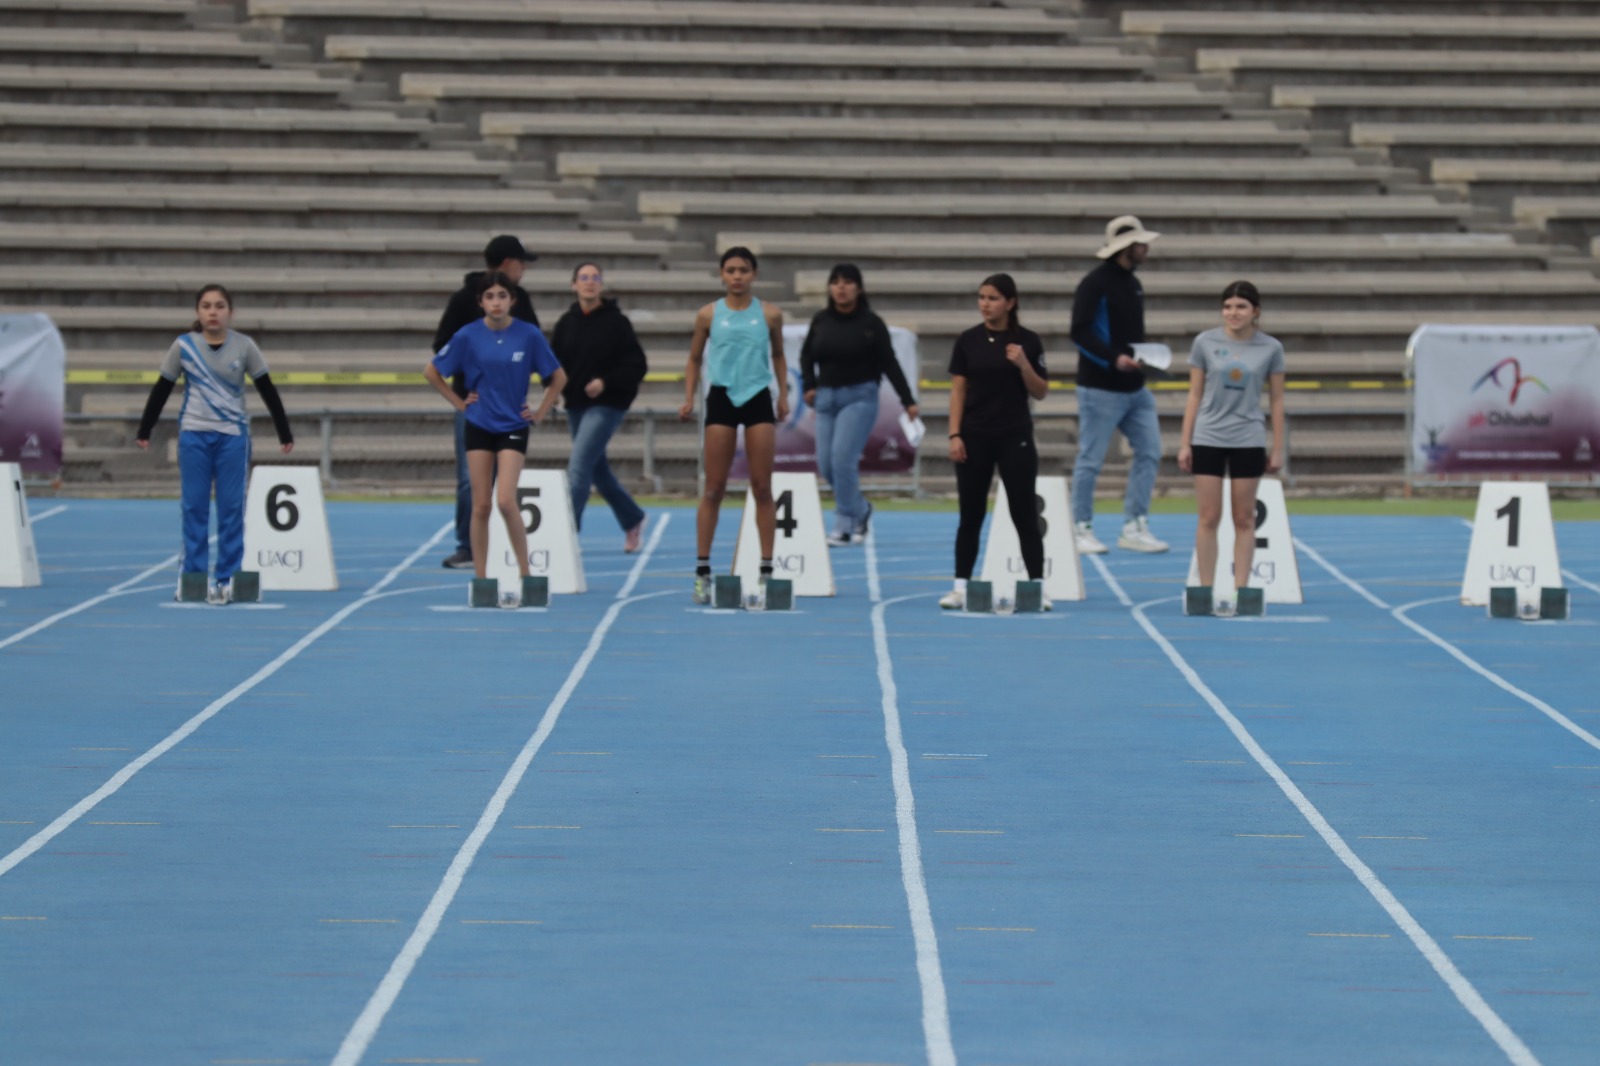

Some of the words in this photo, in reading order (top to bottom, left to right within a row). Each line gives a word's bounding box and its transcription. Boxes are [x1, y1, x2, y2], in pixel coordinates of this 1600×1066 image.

[266, 484, 299, 531] 6
[517, 488, 542, 534] 5
[775, 490, 797, 538] 4
[1496, 497, 1521, 547] 1
[257, 550, 304, 573] UACJ
[504, 550, 549, 572] UCJ
[1489, 565, 1536, 588] UACJ
